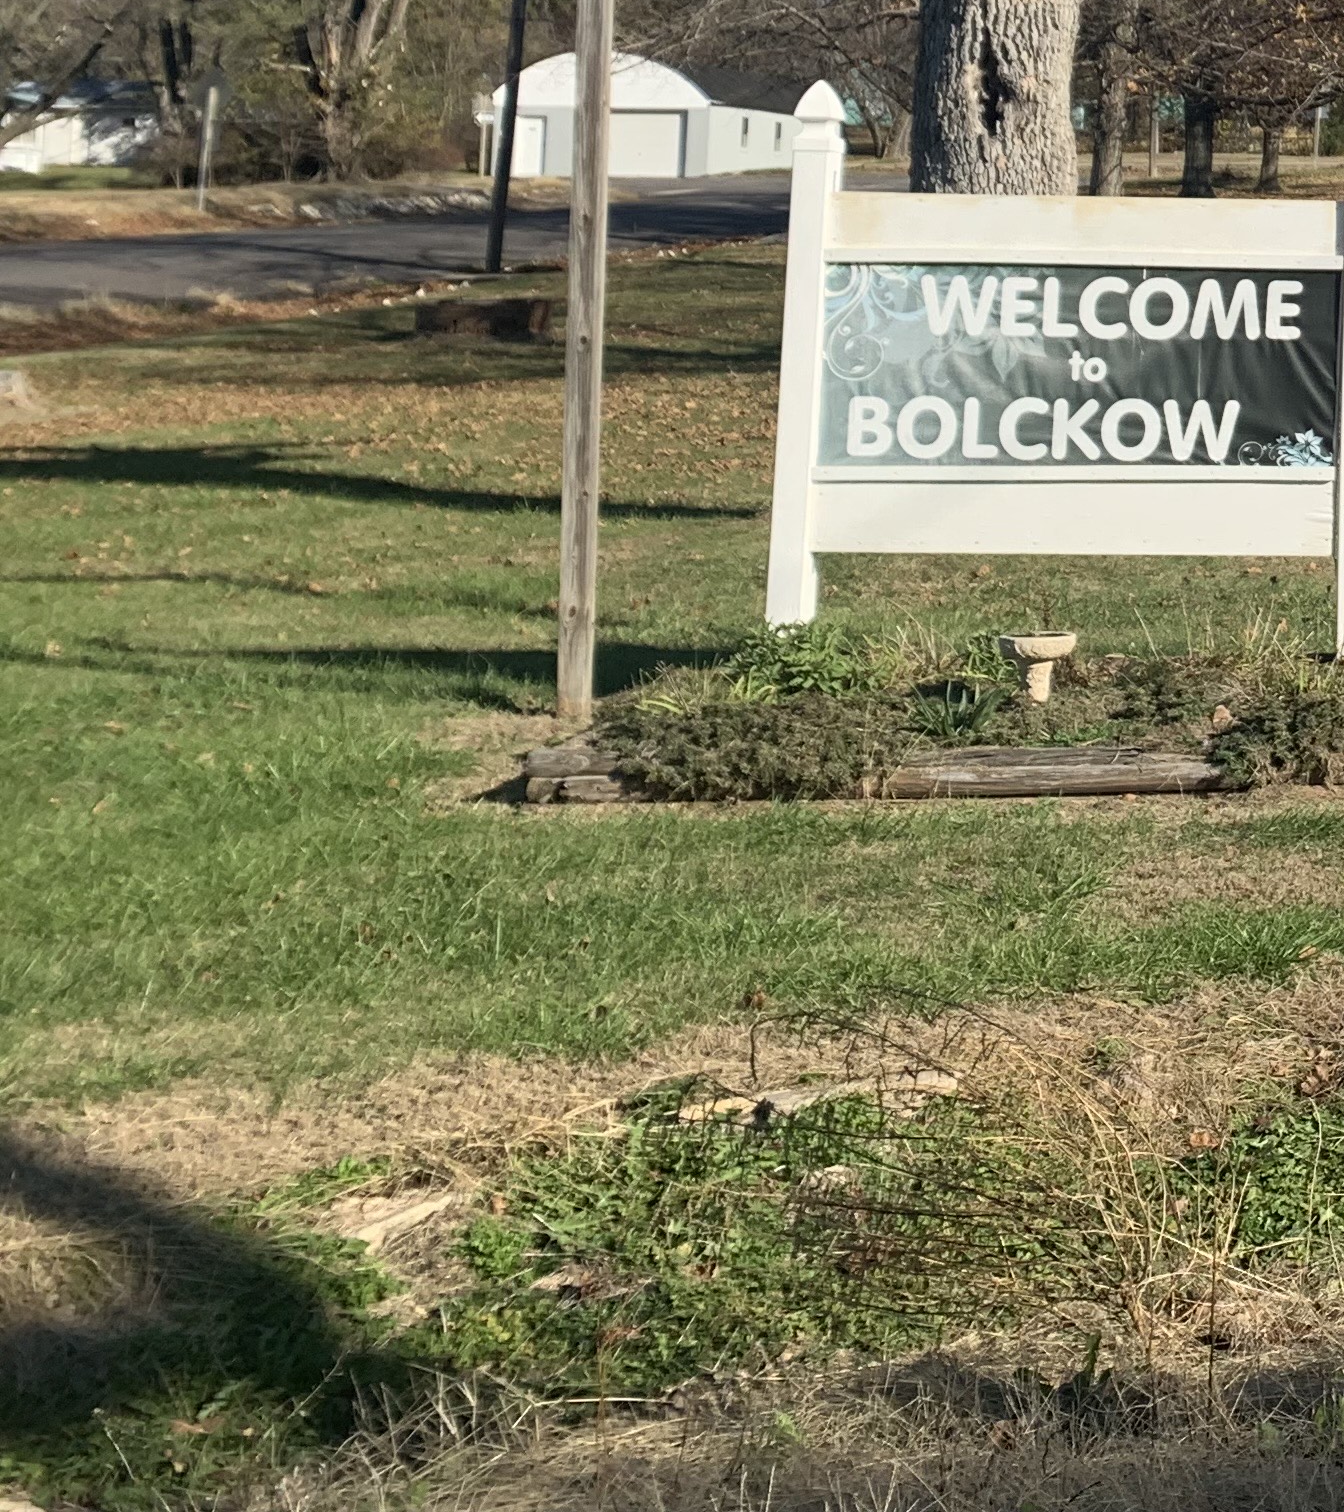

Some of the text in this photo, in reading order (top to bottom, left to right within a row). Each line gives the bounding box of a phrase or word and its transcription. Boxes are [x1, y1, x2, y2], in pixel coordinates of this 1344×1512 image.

[921, 274, 1304, 341] WELCOME
[1069, 350, 1107, 382] to
[845, 395, 1240, 462] BOLCKOW
